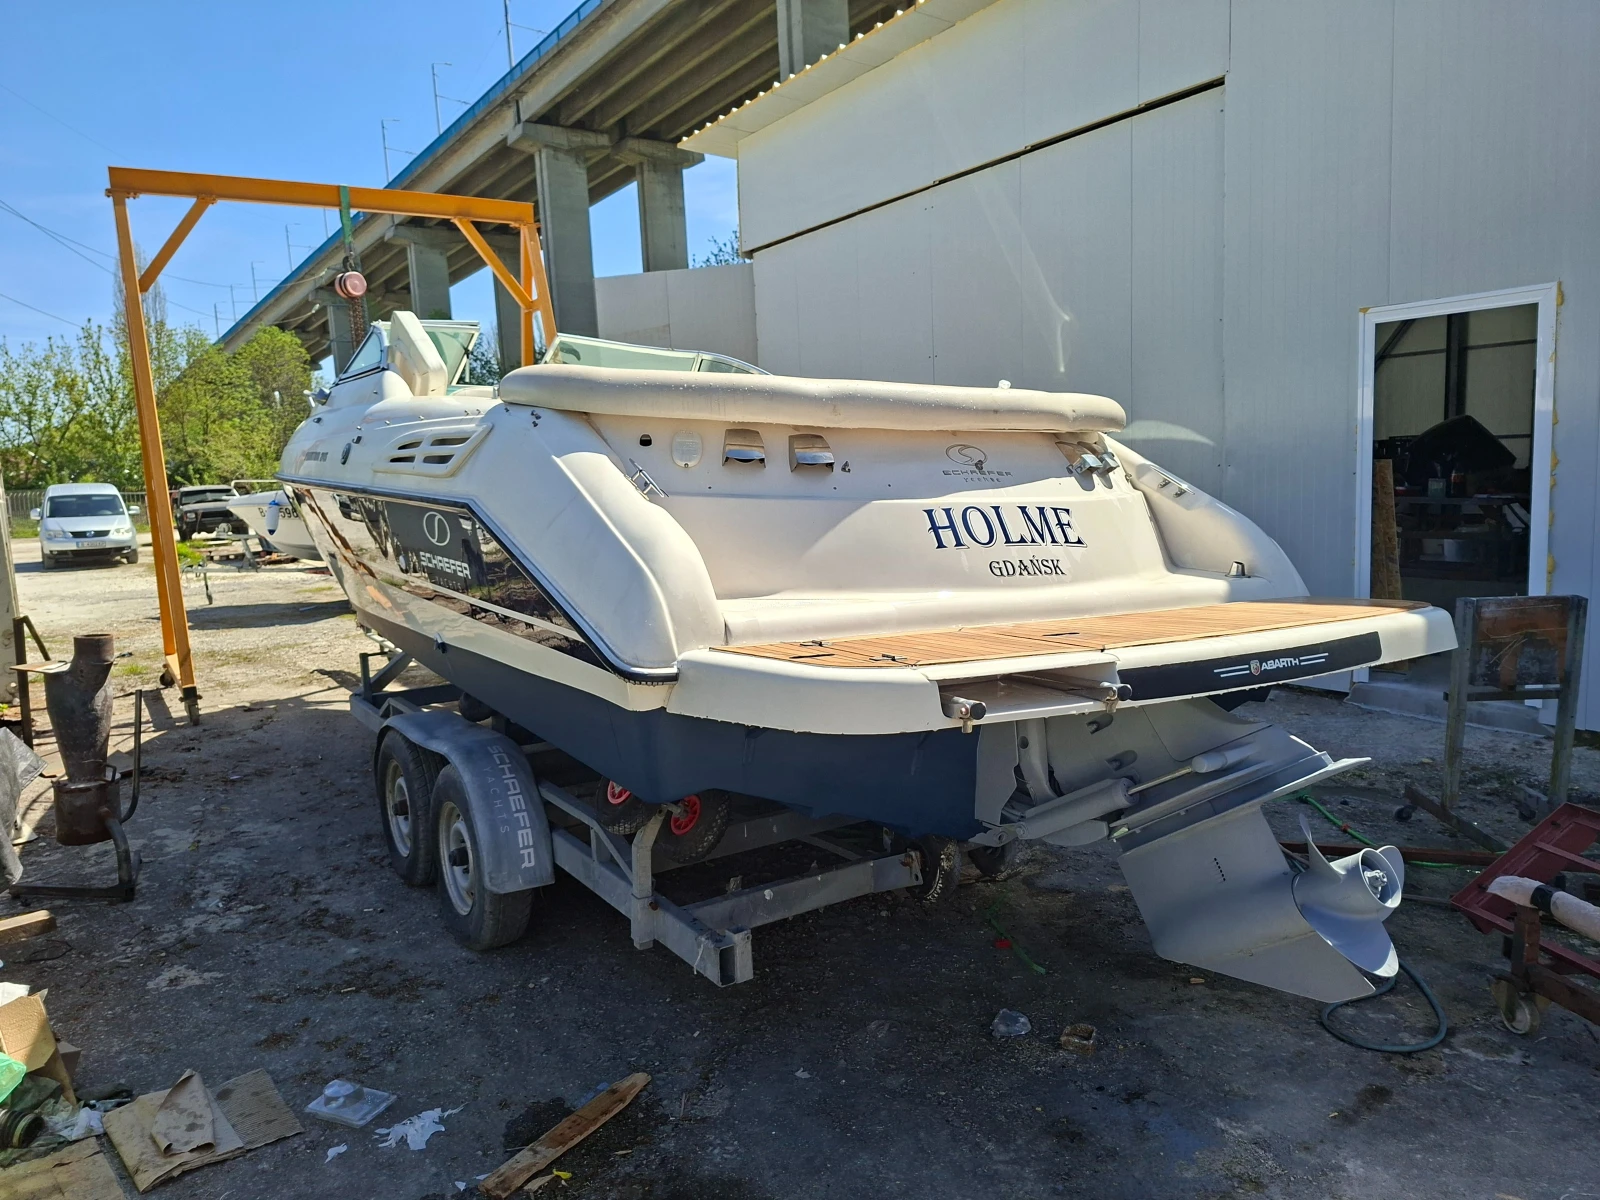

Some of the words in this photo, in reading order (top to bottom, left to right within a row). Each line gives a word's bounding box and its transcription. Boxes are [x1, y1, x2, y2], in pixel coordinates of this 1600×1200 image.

[922, 506, 1088, 550] HOLME
[419, 551, 472, 580] SCHAEFER
[988, 555, 1067, 578] GDAŃSK
[1261, 658, 1300, 671] ABARTH
[483, 765, 510, 834] YACHTS
[487, 744, 536, 870] SCHAEFER
